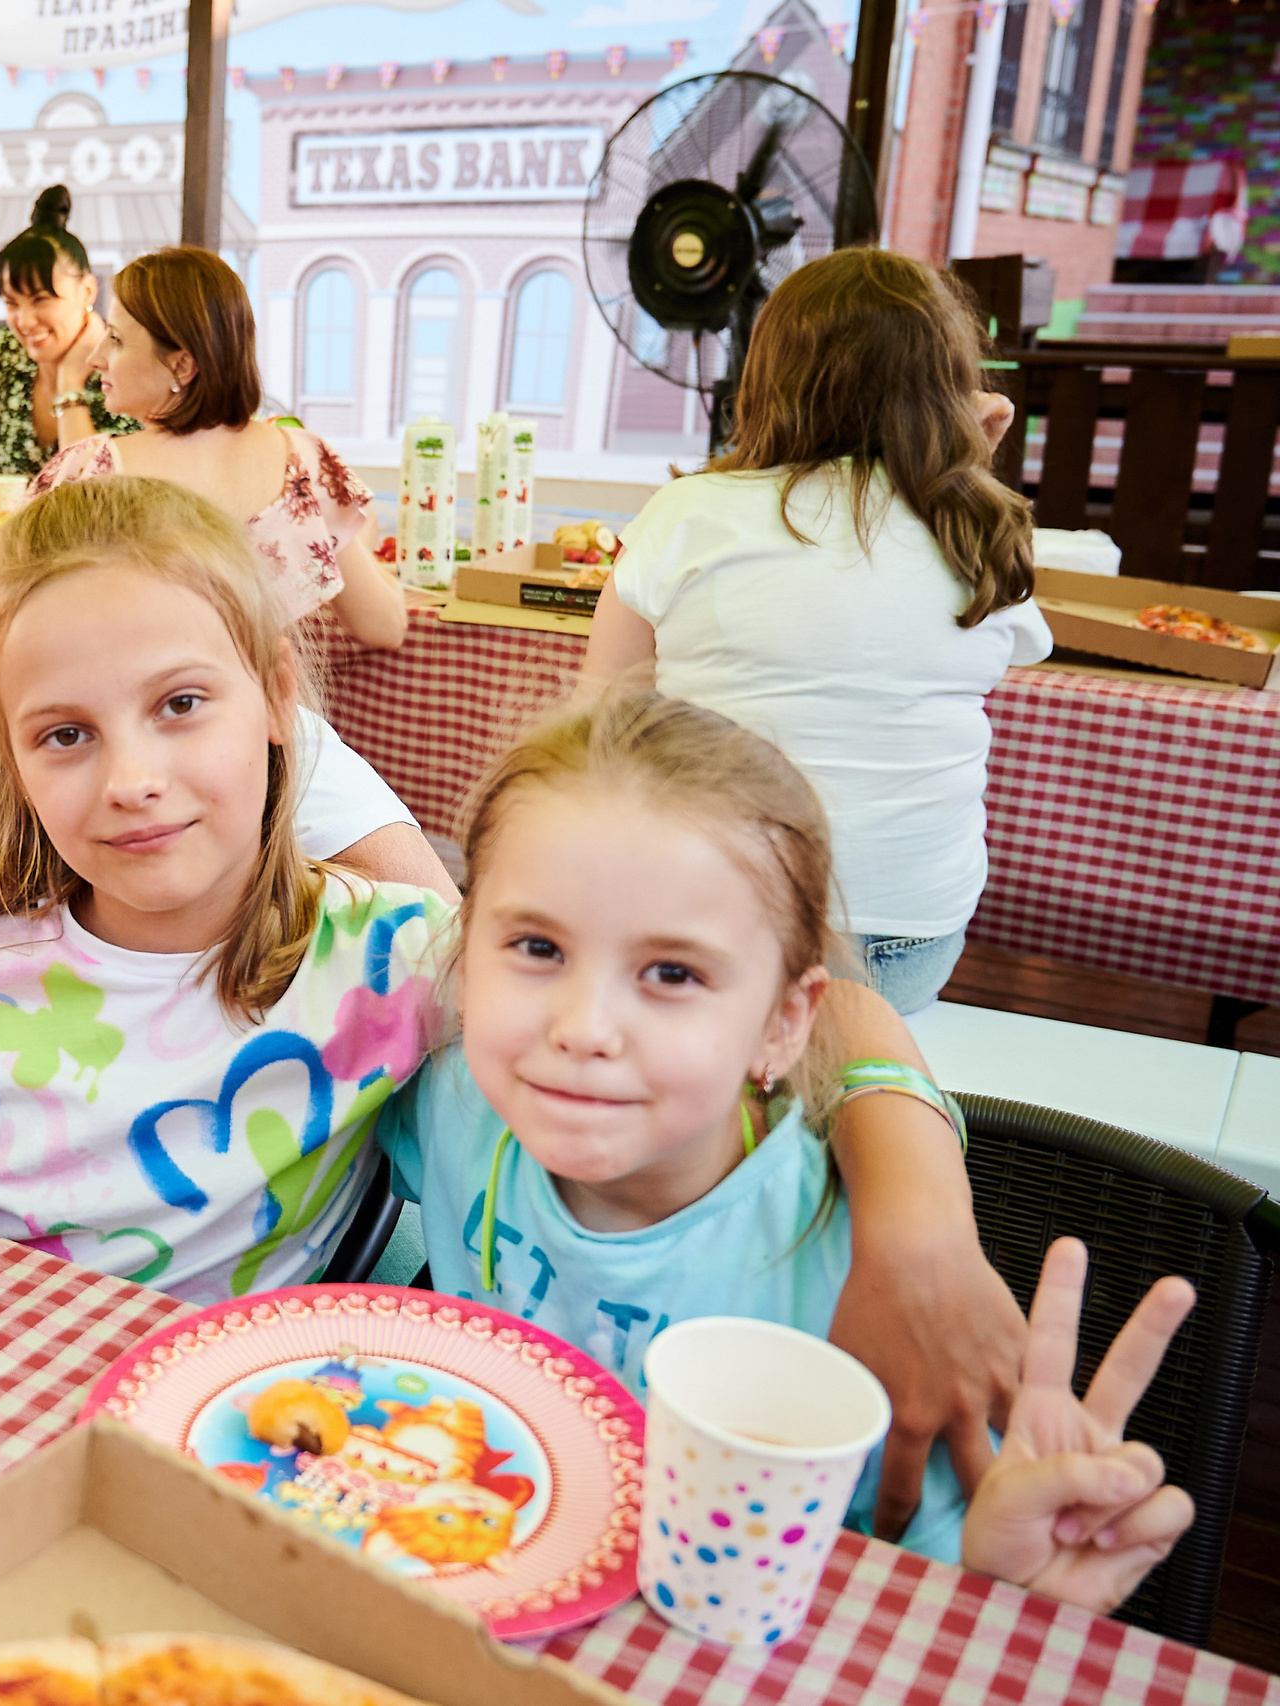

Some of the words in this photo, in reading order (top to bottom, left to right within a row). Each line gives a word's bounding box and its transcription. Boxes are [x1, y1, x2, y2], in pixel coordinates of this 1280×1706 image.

[62, 8, 191, 54] ПРАЗДН
[306, 142, 443, 195] TEXAS
[452, 137, 591, 190] BANK
